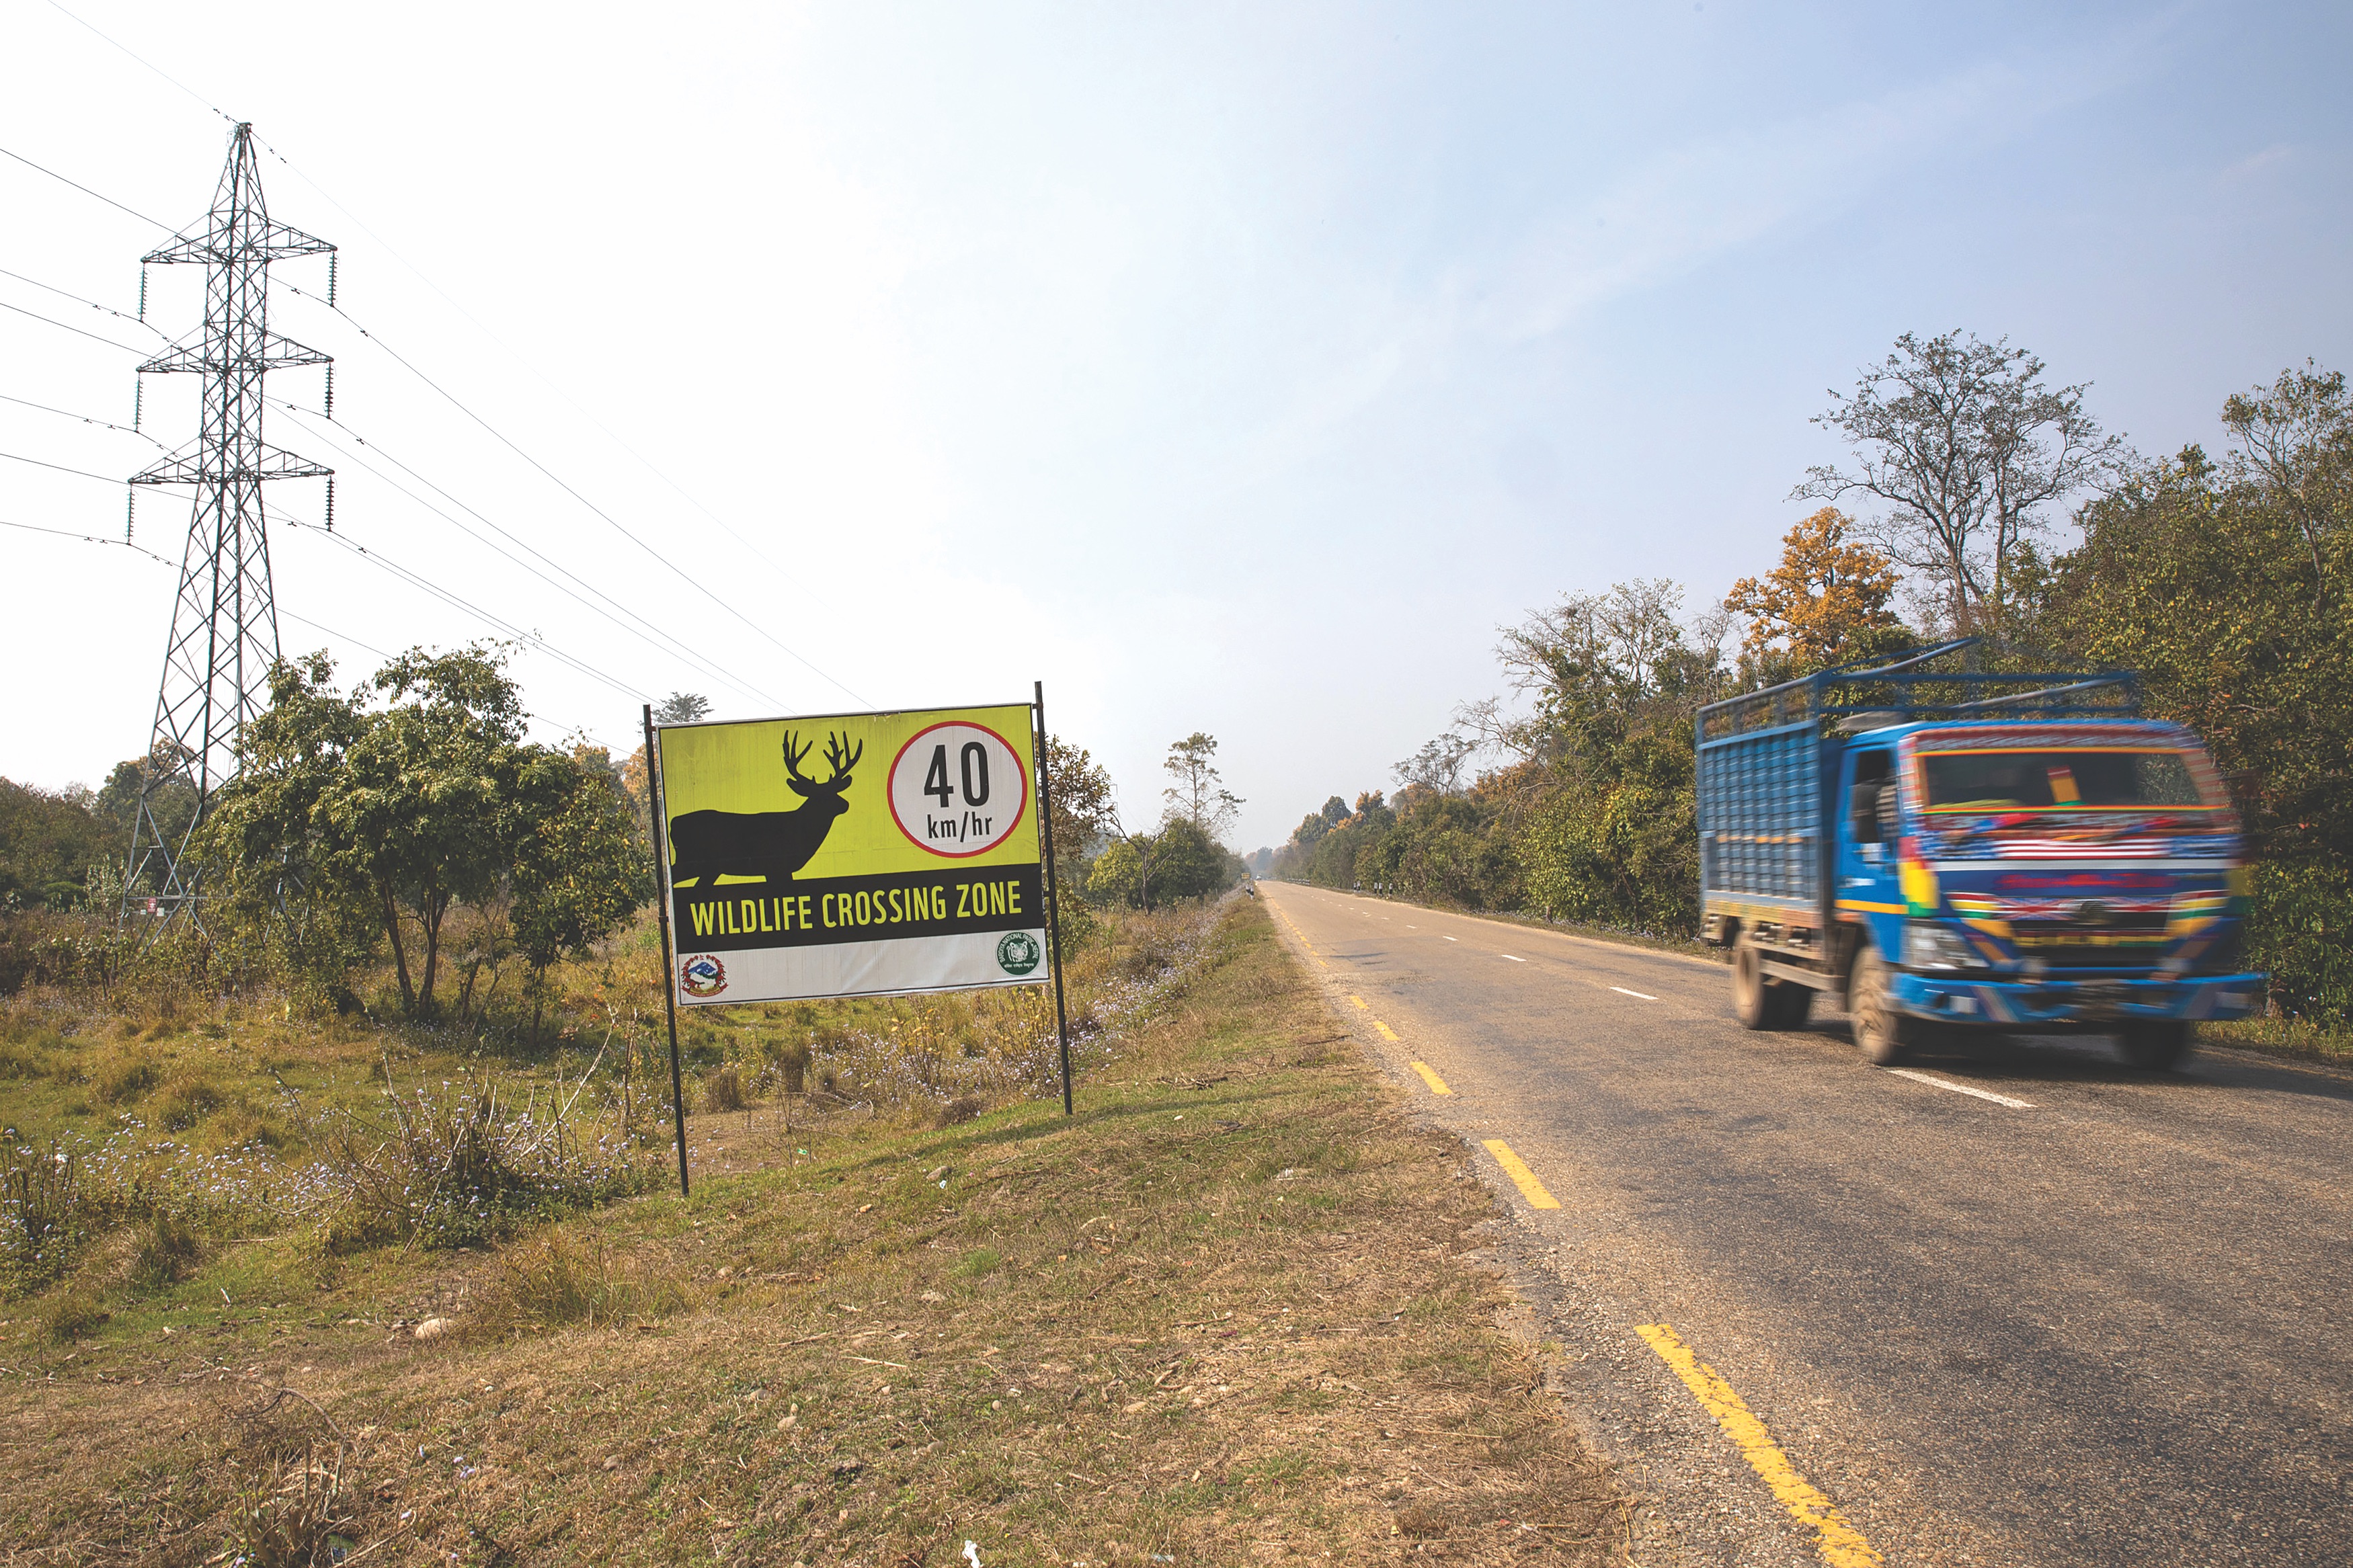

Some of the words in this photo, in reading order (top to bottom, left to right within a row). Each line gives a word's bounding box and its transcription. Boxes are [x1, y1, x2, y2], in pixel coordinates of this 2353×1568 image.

[924, 742, 989, 807] 40
[928, 811, 992, 842] km/hr
[690, 896, 812, 936] WILDLIFE
[822, 886, 946, 927] CROSSING
[956, 881, 1021, 917] ZONE
[1002, 933, 1022, 944] NATIONAL
